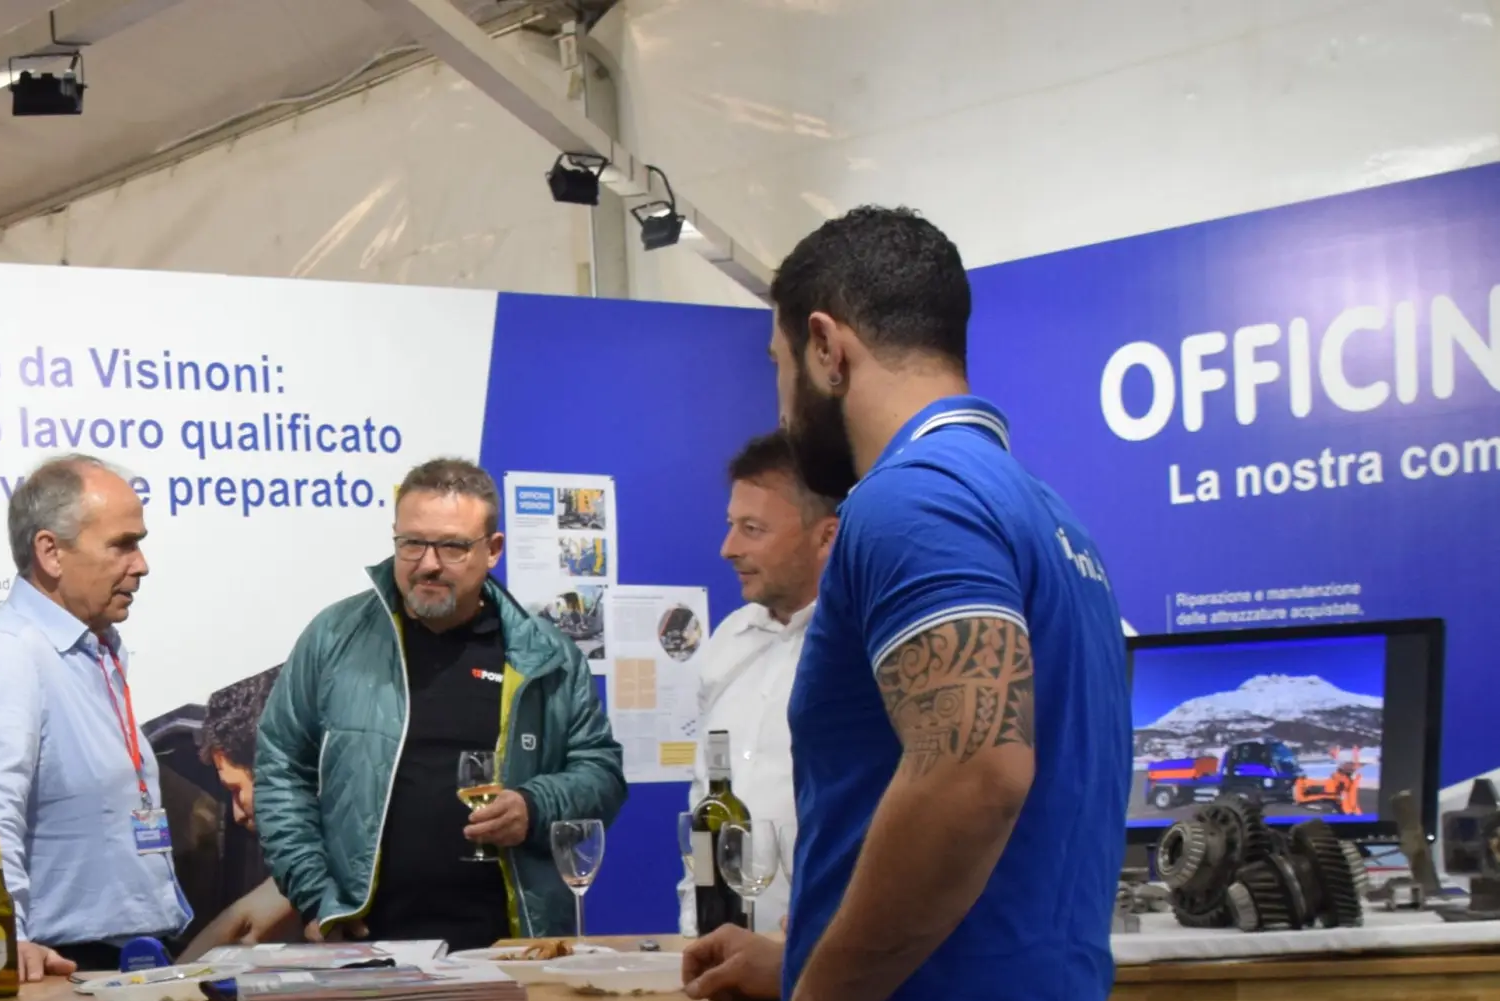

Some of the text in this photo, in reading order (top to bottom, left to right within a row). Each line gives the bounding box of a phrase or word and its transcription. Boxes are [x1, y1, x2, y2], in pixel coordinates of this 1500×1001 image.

[18, 345, 74, 388] da
[89, 347, 285, 394] Visinoni:
[1100, 283, 1500, 442] OFFICIN
[18, 406, 164, 450] lavoro
[180, 412, 402, 460] qualificato
[169, 470, 385, 517] preparato.
[1169, 463, 1220, 505] La
[1236, 445, 1383, 499] nostra
[1176, 582, 1362, 608] Riparazione e manutenzione
[1176, 610, 1208, 626] delle
